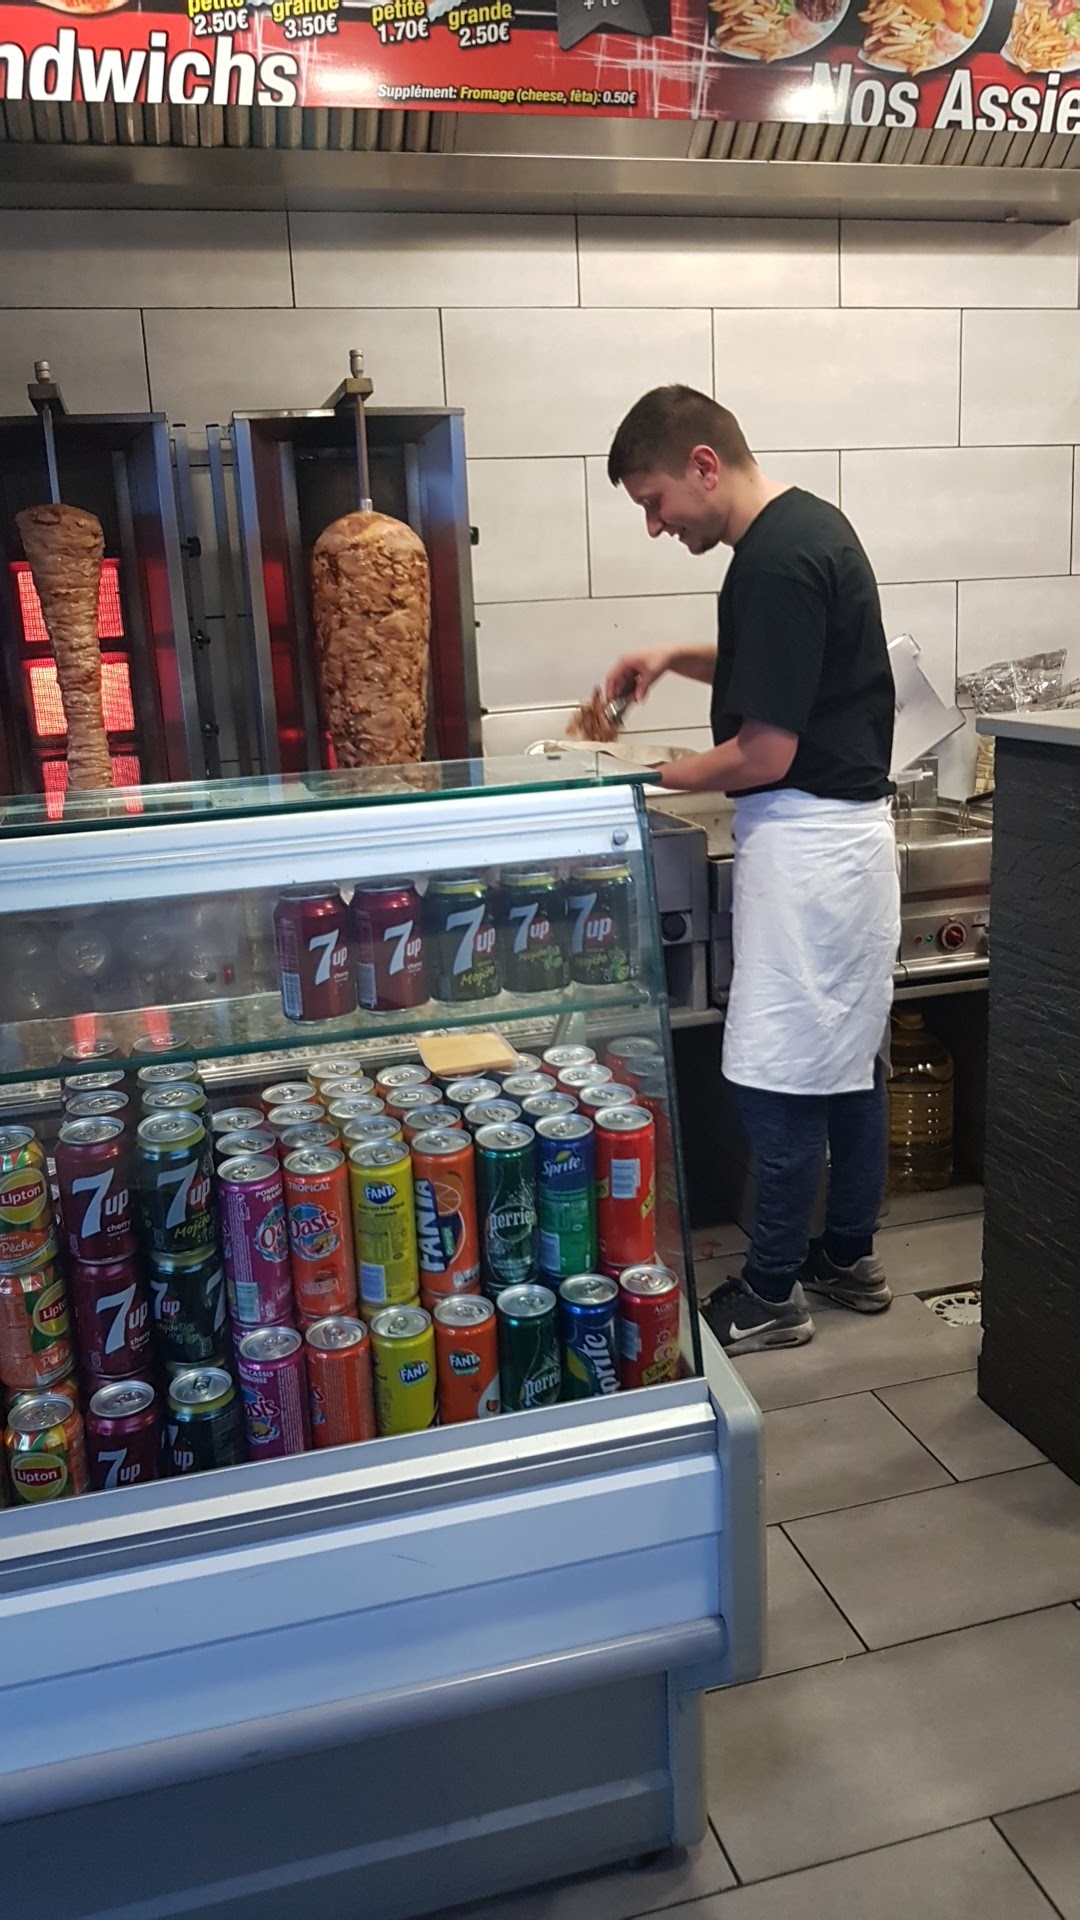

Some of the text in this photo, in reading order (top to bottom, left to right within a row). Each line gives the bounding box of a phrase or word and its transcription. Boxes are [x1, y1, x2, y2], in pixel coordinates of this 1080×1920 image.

[194, 9, 249, 36] 2.50€
[284, 13, 338, 39] 3.50€
[372, 0, 426, 26] petite
[448, 2, 513, 31] grande
[377, 18, 429, 43] 1.70€
[459, 22, 510, 47] 2.50€
[377, 84, 457, 100] Supplément:
[459, 86, 515, 104] Fromage
[516, 88, 567, 105] (cheese,
[602, 90, 637, 105] 0.50€
[811, 62, 920, 128] Nos
[542, 1157, 582, 1178] Sprite
[577, 1333, 621, 1396] prite
[16, 1468, 58, 1484] Lipton
